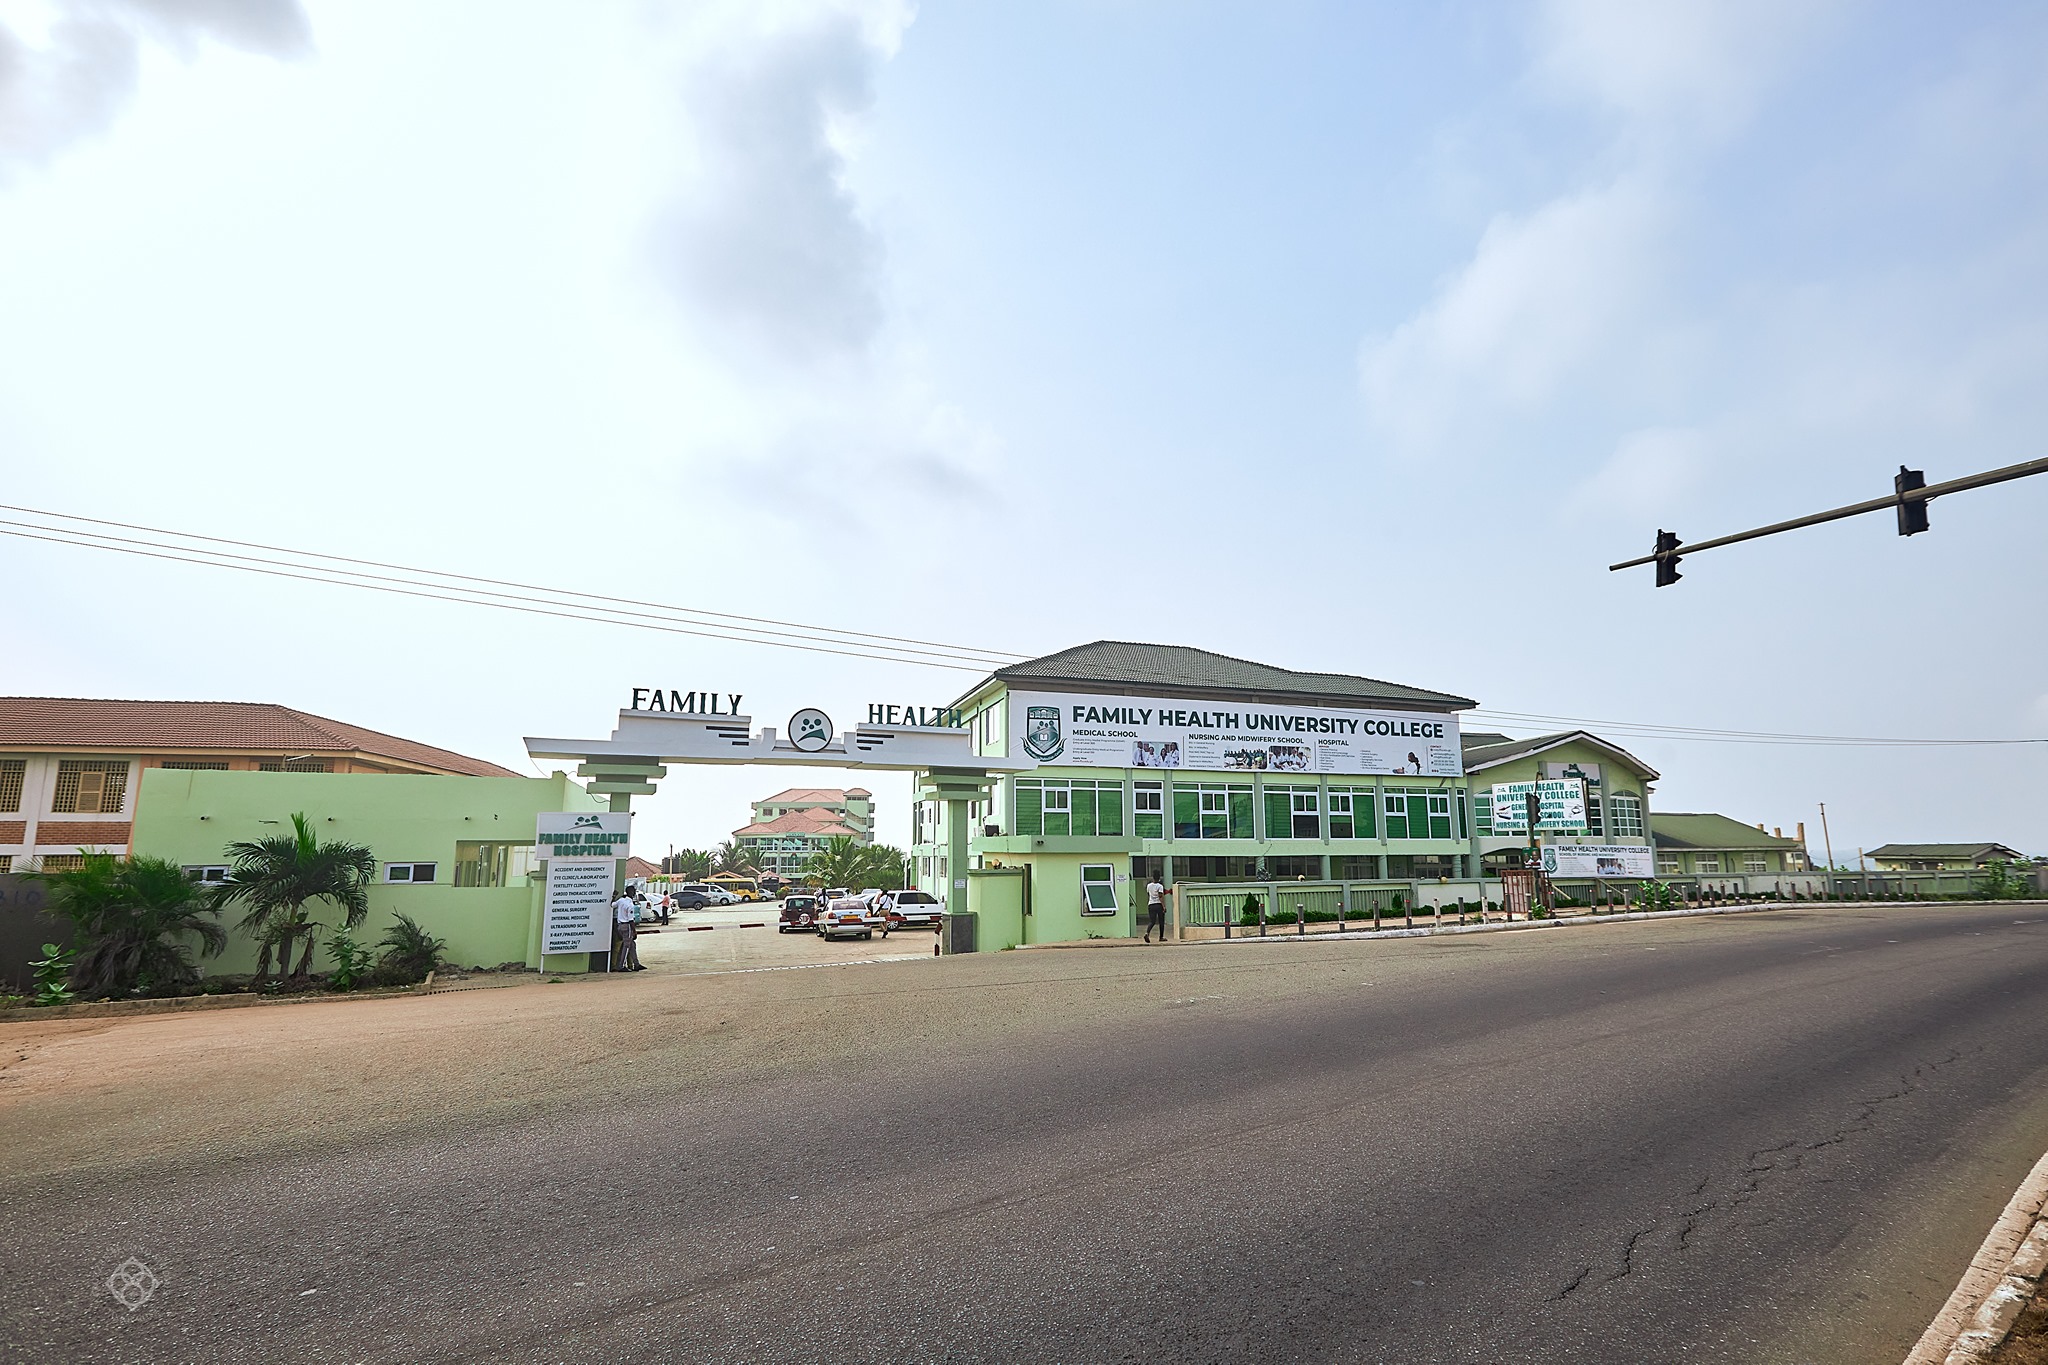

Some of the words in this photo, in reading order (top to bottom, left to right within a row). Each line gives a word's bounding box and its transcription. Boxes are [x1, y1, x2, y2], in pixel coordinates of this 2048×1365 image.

[632, 688, 743, 716] FAMILY
[868, 703, 963, 729] HEALTH
[1072, 705, 1152, 725] FAMILY
[1159, 709, 1239, 729] HEALTH
[1246, 713, 1358, 734] UNIVERSITY
[1363, 720, 1444, 739] COLLEGE
[1072, 729, 1106, 737] MEDICAL
[1107, 730, 1138, 738] SCHOOL
[1188, 733, 1220, 741] NURSING
[1220, 734, 1237, 742] AND
[1237, 735, 1276, 743] MIDWIFERY
[1562, 770, 1586, 779] Family
[1508, 783, 1535, 793] FAMILY
[1536, 782, 1564, 791] HEALTH
[1496, 791, 1542, 802] UNIVERY
[1544, 790, 1580, 800] COLLEGE
[1540, 811, 1565, 819] SCHOOL
[1496, 821, 1520, 829] NURSING
[538, 833, 582, 844] FAMILY
[584, 833, 628, 844] HEALTH
[553, 844, 612, 856] HOSPITAL
